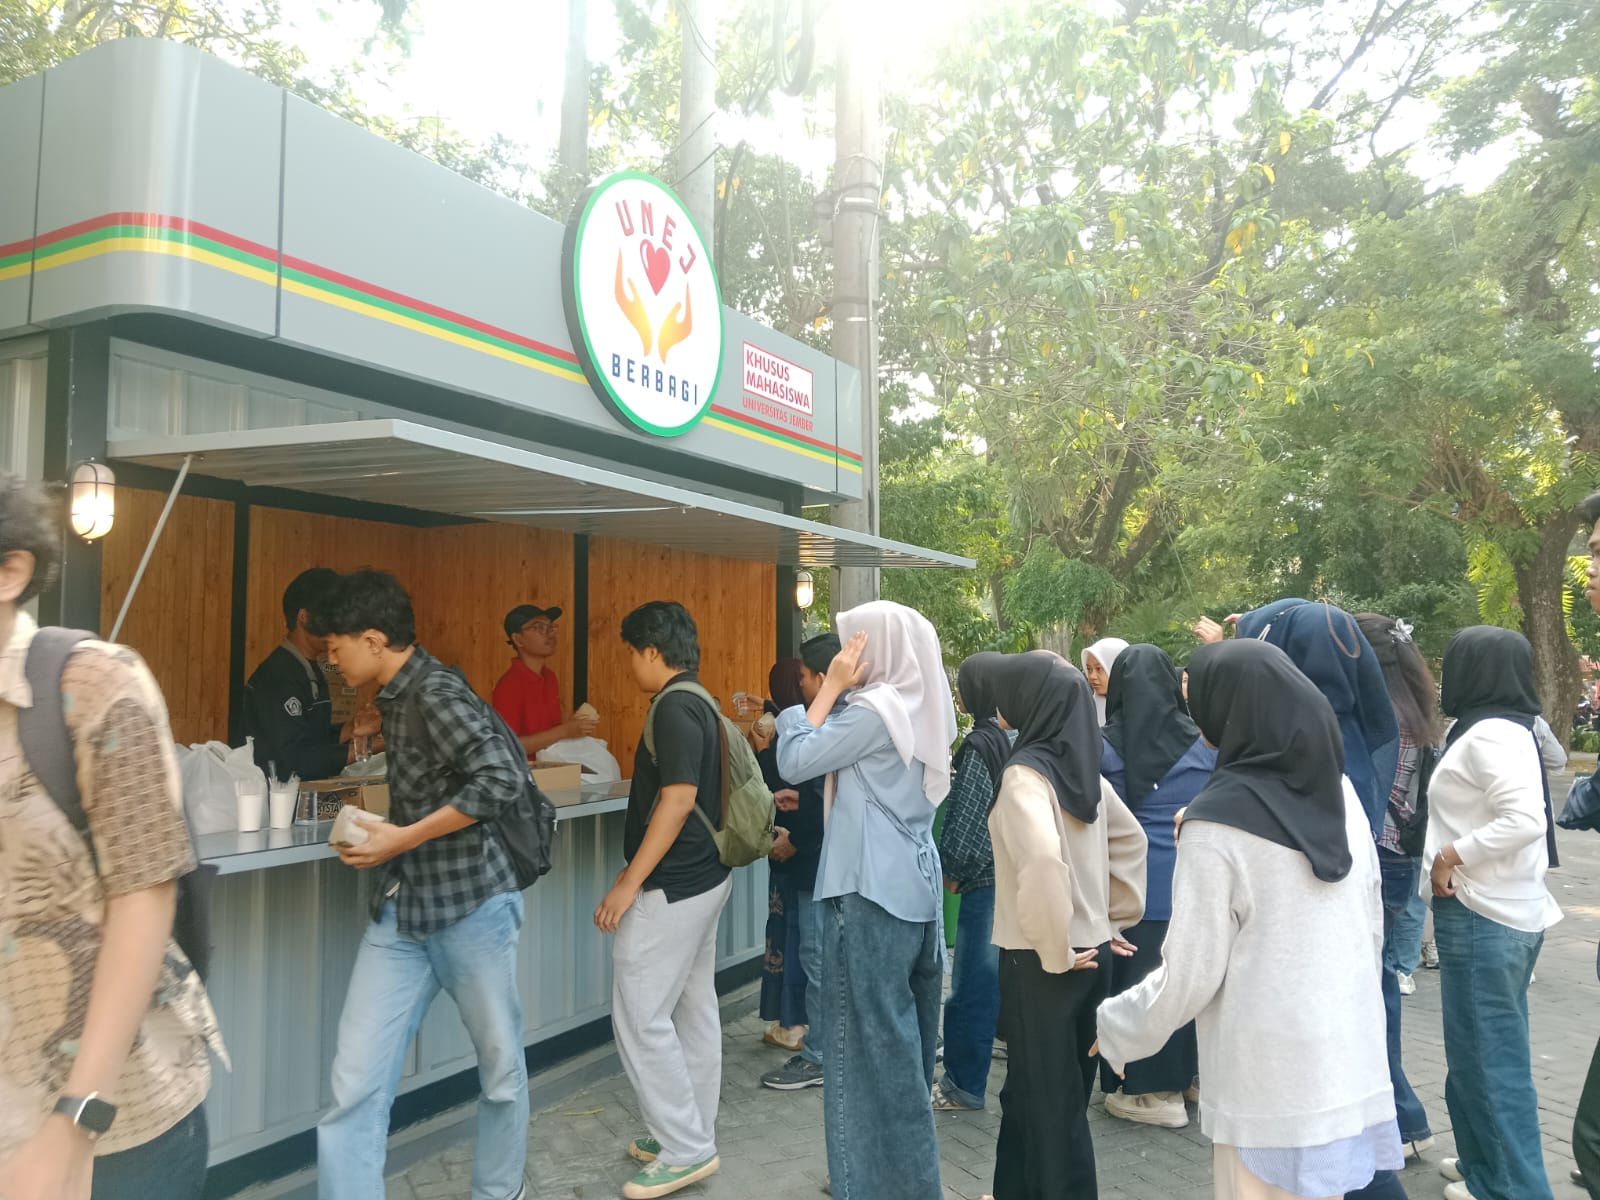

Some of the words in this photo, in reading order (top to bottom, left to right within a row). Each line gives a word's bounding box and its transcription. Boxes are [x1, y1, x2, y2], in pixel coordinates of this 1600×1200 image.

[615, 199, 696, 274] UNEJ
[612, 353, 697, 406] BERBAGI
[746, 349, 790, 382] KHUSUS
[746, 370, 810, 409] MAHASISWA
[742, 396, 788, 423] UNIVERSITAS
[789, 413, 814, 432] JEMBER
